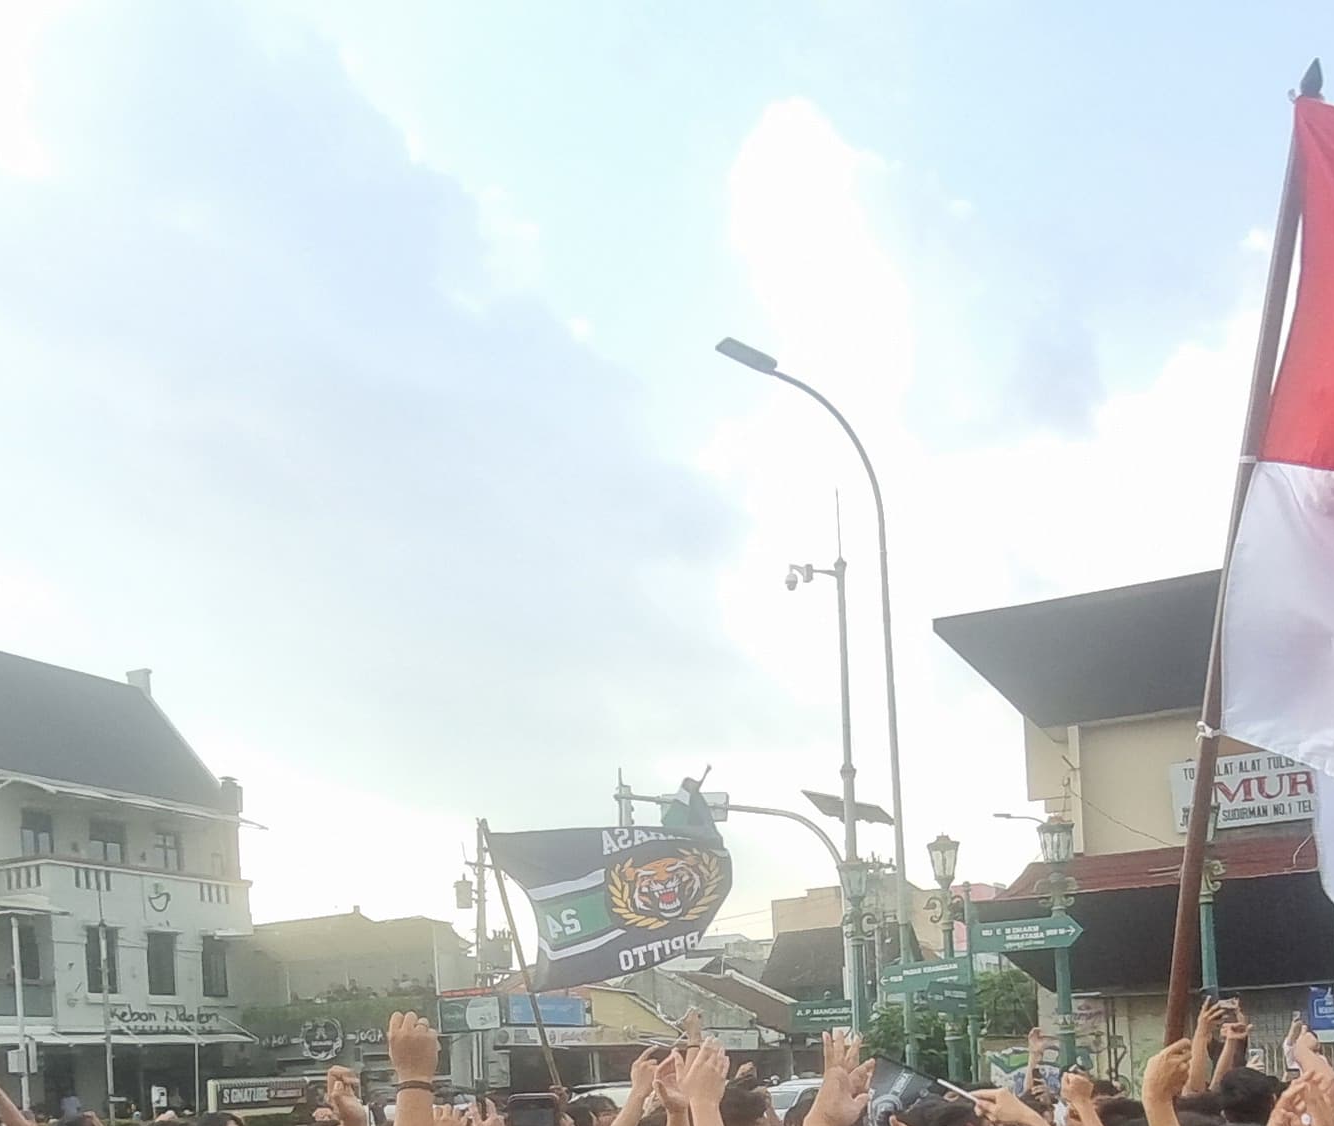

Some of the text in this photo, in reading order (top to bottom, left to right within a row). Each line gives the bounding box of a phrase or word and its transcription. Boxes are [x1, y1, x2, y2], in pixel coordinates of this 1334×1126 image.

[1239, 758, 1261, 773] ALAT
[1212, 770, 1315, 804] MUR
[1222, 806, 1268, 822] SUDIRMAN
